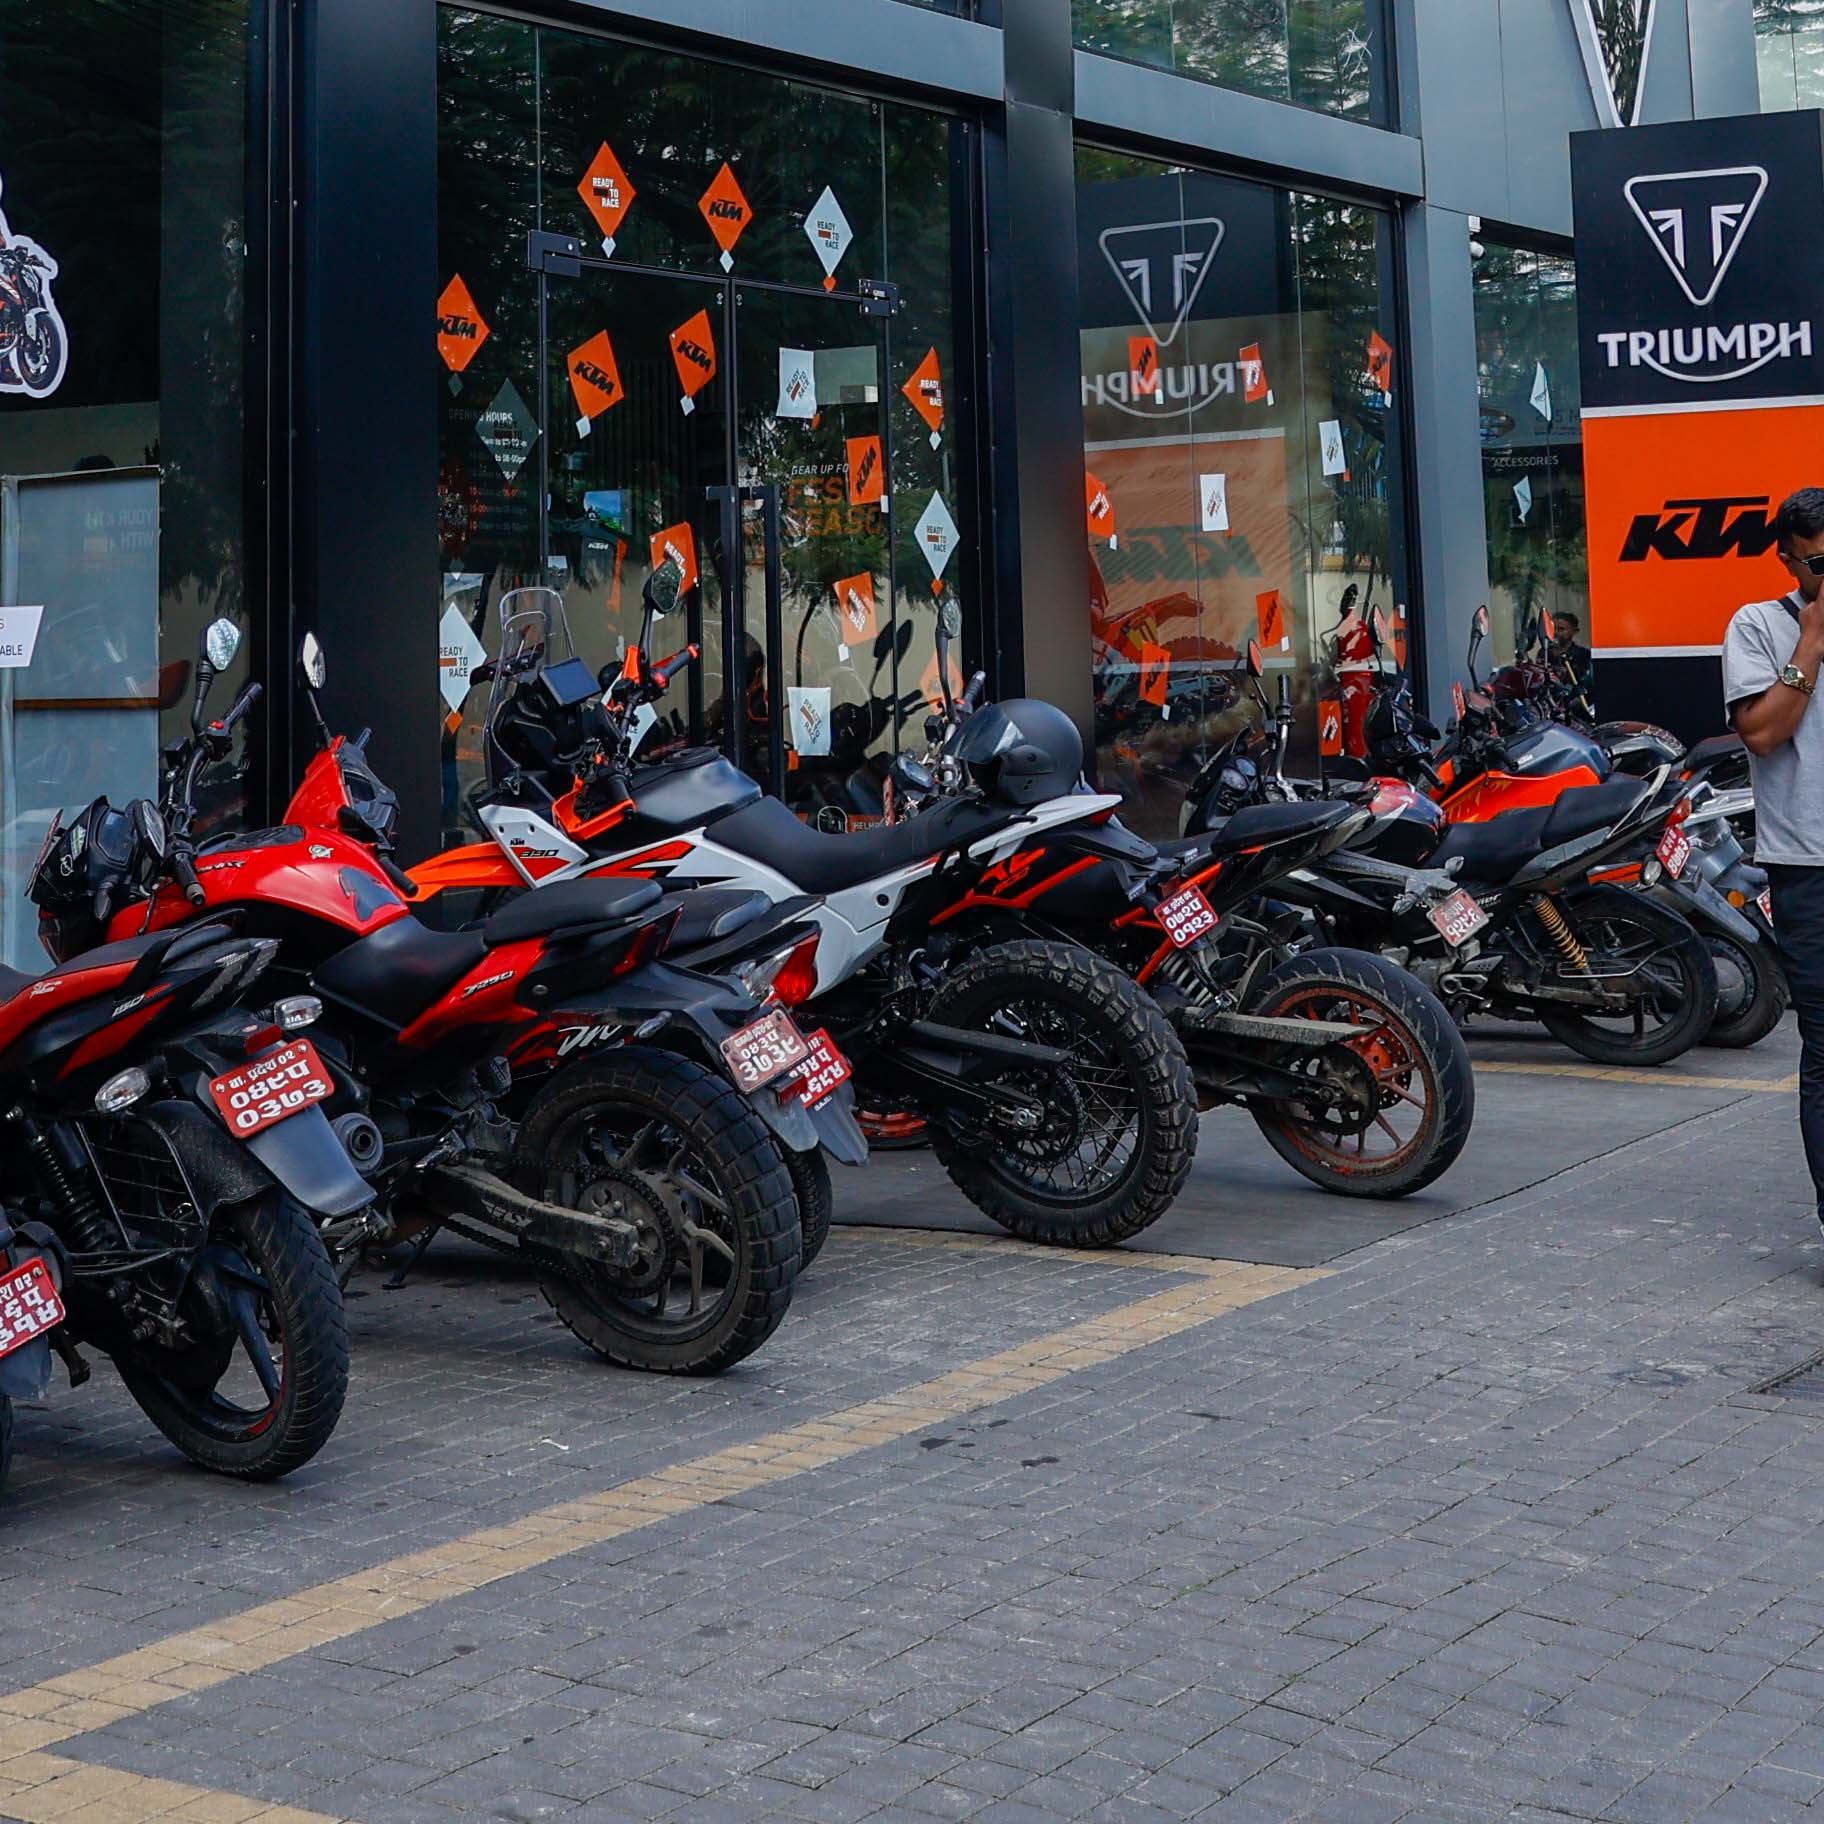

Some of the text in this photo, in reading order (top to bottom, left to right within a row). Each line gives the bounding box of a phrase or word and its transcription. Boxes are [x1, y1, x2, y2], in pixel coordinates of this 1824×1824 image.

[592, 177, 614, 188] READY
[609, 188, 619, 198] TO
[601, 197, 620, 208] RACE
[709, 198, 744, 222] KTM
[817, 220, 836, 231] READY
[831, 231, 840, 241] TO
[824, 240, 839, 250] RACE
[438, 314, 477, 339] KTM
[677, 339, 712, 373] KTM
[1598, 321, 1812, 382] TRIUMPH
[574, 361, 614, 395] KTM
[785, 368, 800, 394] READY
[485, 411, 513, 424] HOURS
[1490, 456, 1560, 468] ACCESSORIES
[791, 463, 850, 476] GEAR UP FO
[927, 525, 943, 534] READY
[1619, 495, 1786, 562] KTM
[940, 535, 947, 543] TO
[664, 541, 685, 565] READY
[934, 543, 946, 552] RACE
[440, 646, 463, 656] READY
[459, 656, 468, 667] TO
[449, 666, 468, 677] RACE
[804, 698, 821, 727] READY
[510, 838, 525, 846] KTM
[520, 850, 560, 858] 390
[246, 1063, 277, 1081] प्रदेश
[278, 1050, 296, 1065] ०२
[236, 1079, 328, 1129] ०३७३
[14, 1272, 33, 1292] ०२
